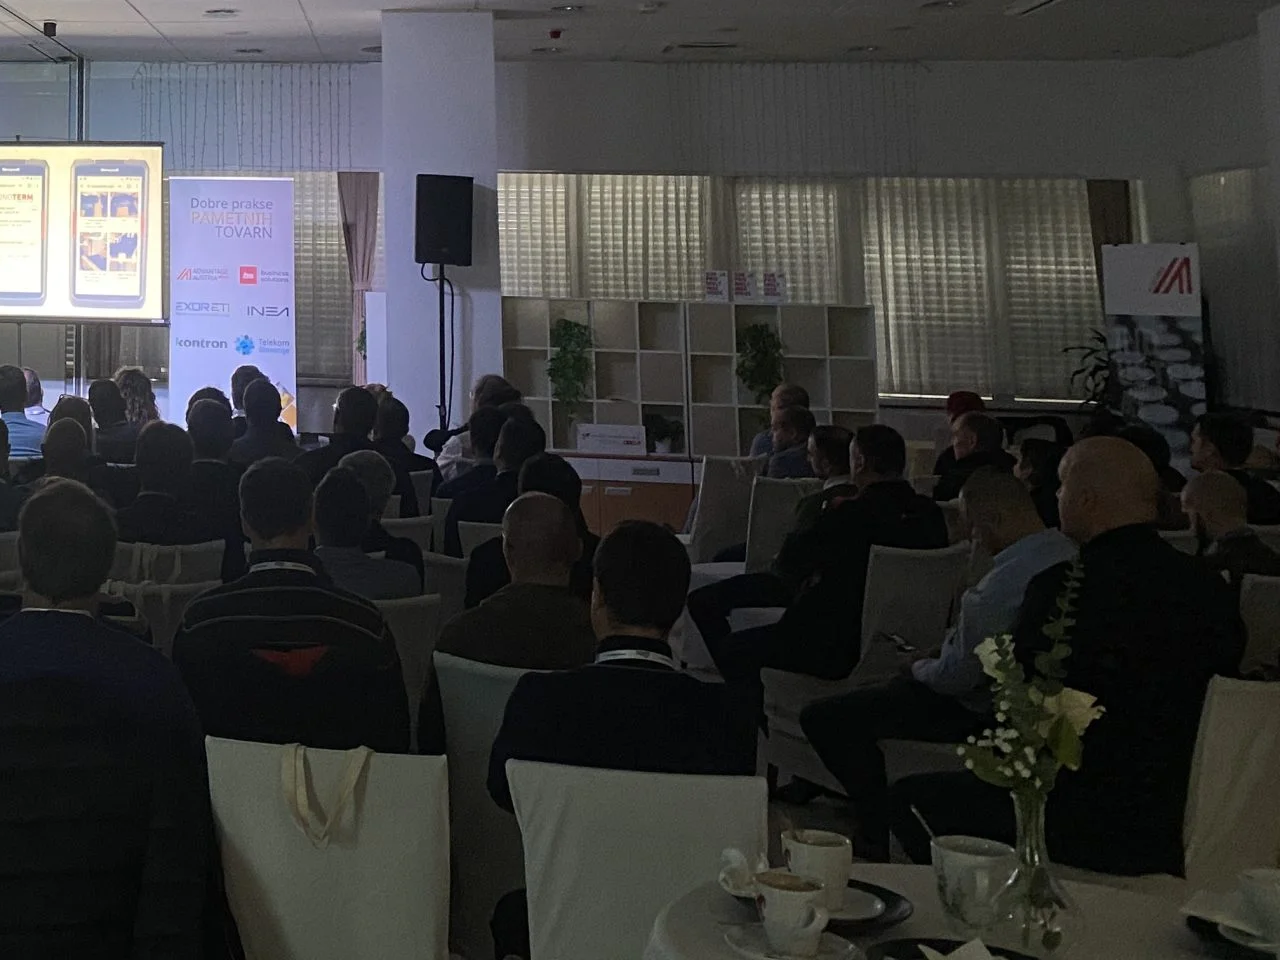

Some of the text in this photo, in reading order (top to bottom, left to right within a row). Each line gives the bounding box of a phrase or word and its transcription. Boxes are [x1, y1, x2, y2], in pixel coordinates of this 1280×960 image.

[191, 197, 273, 212] Dobre prakse
[191, 212, 272, 225] PAMETNIH
[215, 226, 272, 238] TOVARN
[176, 337, 228, 349] kontron
[259, 338, 290, 347] Telekom
